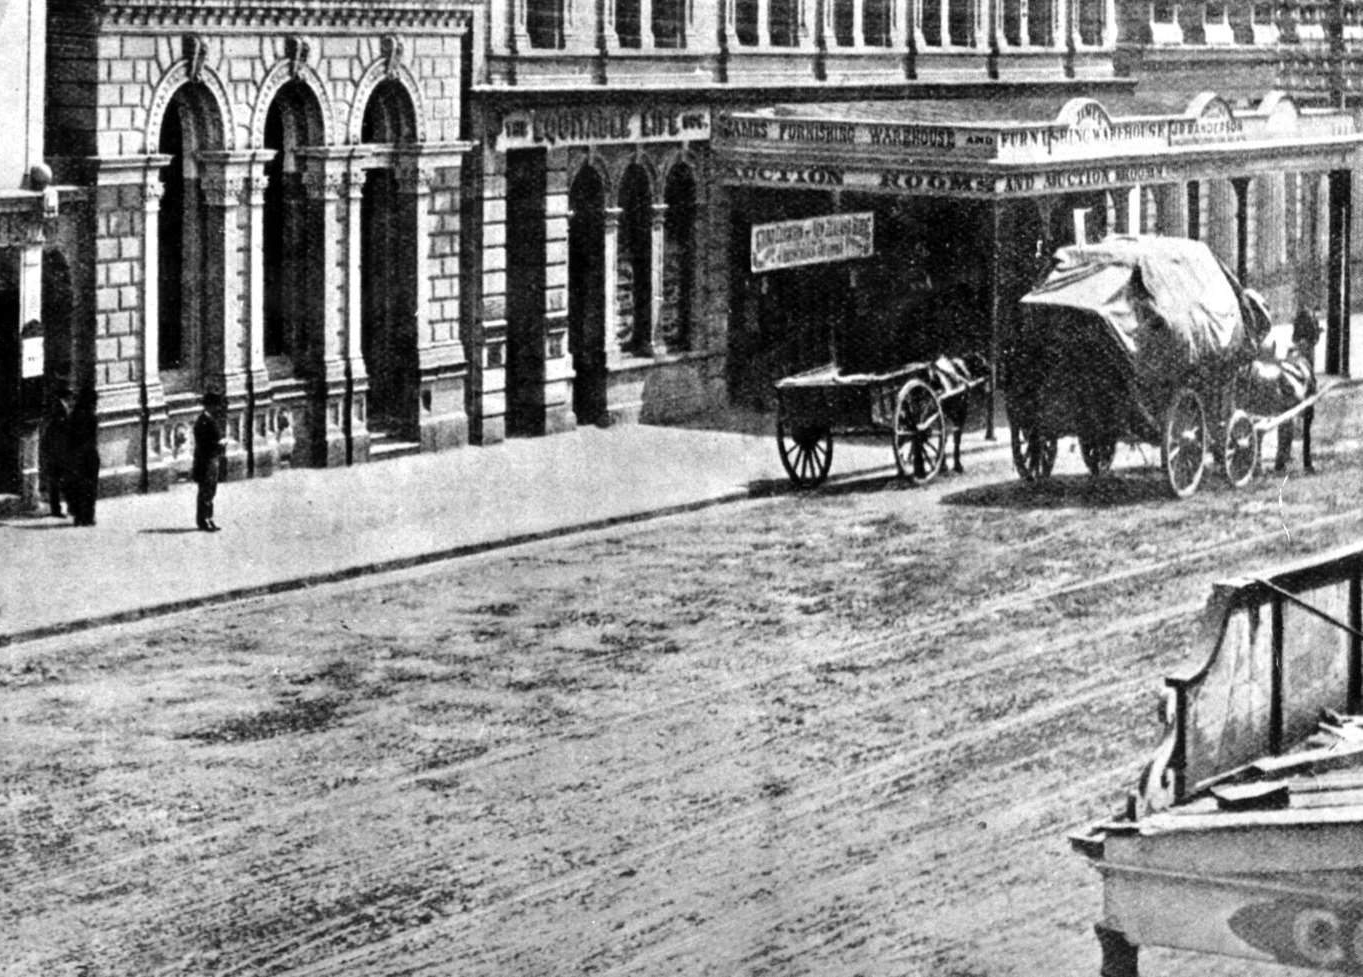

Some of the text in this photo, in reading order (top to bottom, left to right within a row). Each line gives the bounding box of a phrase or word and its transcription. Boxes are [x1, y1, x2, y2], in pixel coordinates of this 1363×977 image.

[532, 108, 629, 145] EQUITABLE
[641, 110, 680, 136] LIFE
[777, 124, 855, 143] FURNISHING
[869, 127, 955, 148] WAREHOUSE
[966, 135, 994, 145] AND
[725, 169, 996, 196] AUCTION ROOMS
[1005, 176, 1035, 192] AND
[1045, 171, 1110, 188] AUCTION
